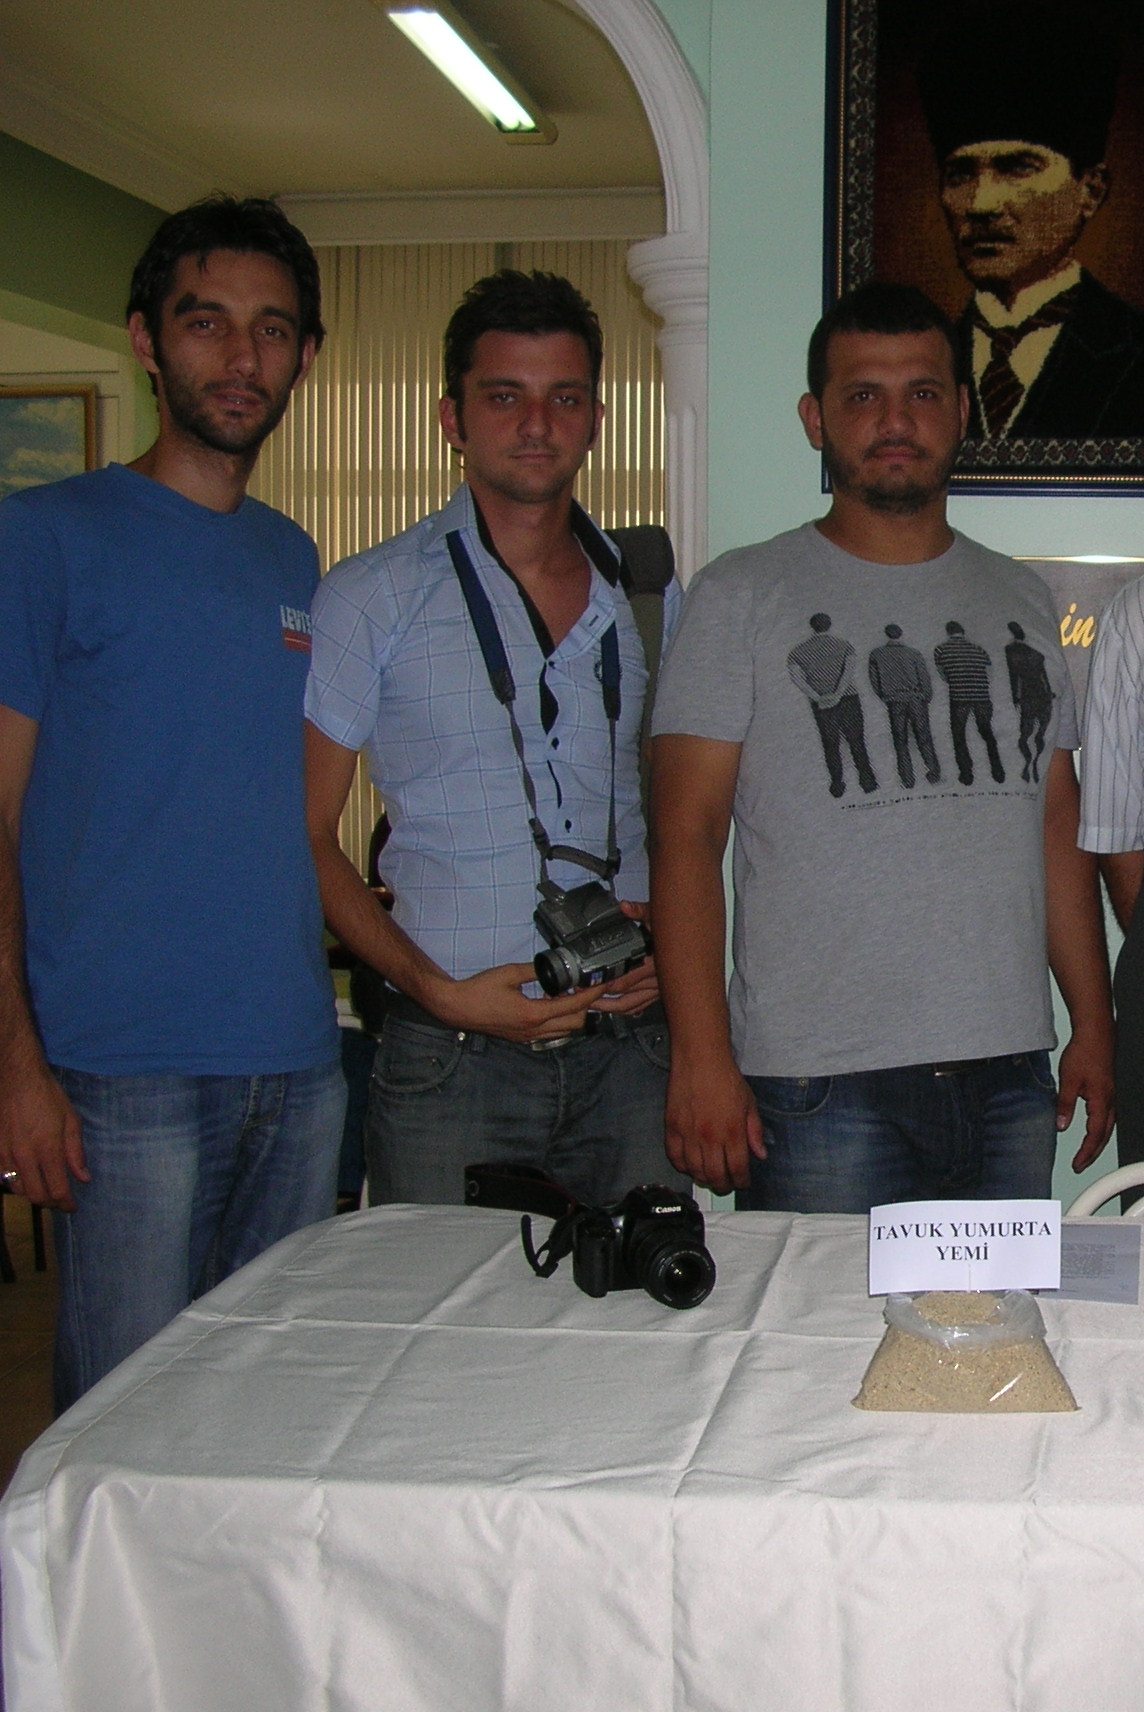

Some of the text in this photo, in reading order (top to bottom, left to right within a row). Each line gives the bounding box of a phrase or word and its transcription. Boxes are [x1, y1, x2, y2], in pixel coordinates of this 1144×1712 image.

[655, 1205, 682, 1214] Canon
[873, 1220, 1053, 1240] TAVUK YUMURTA
[936, 1242, 990, 1261] YEMİ
